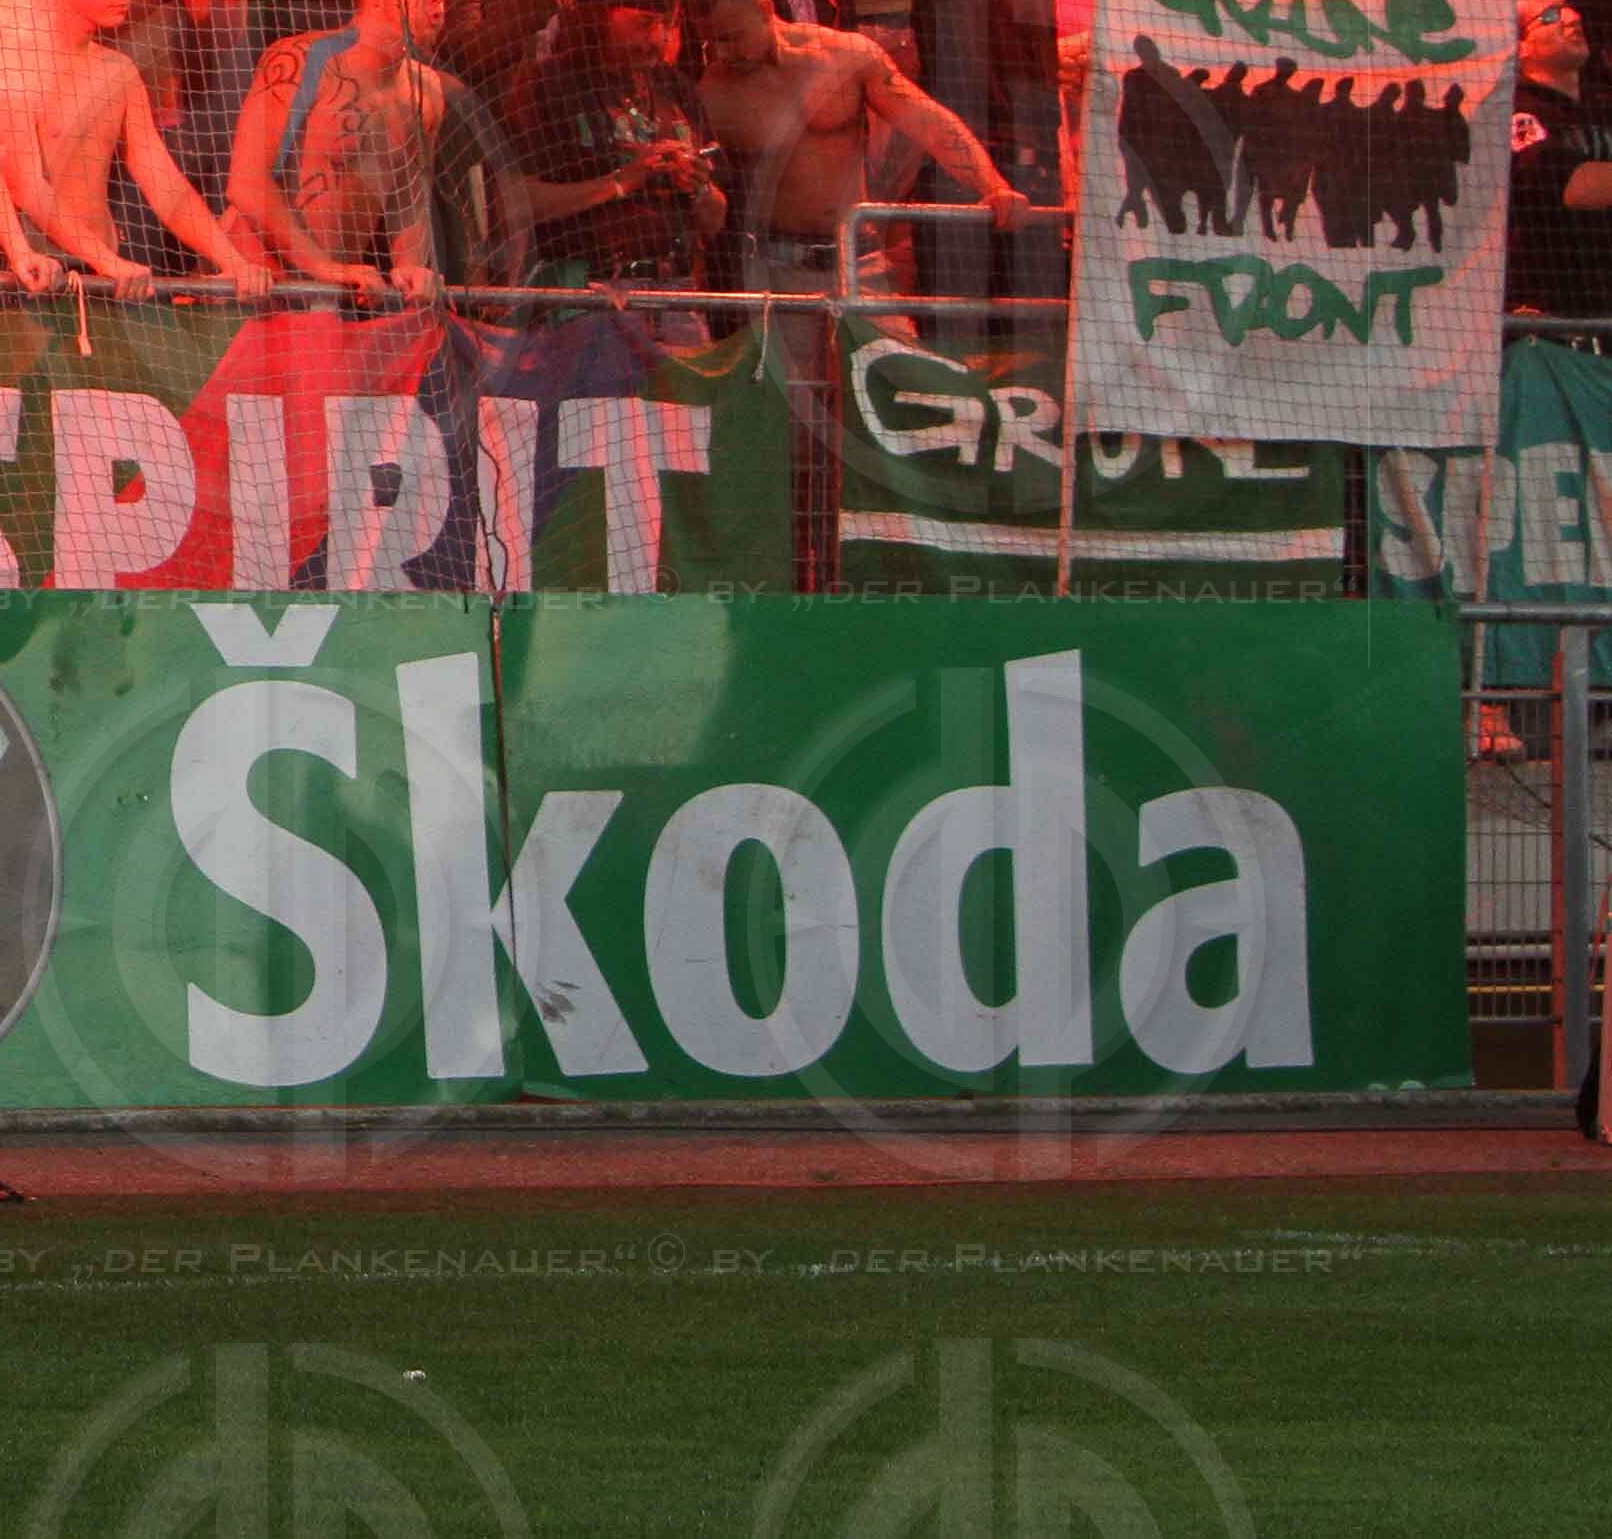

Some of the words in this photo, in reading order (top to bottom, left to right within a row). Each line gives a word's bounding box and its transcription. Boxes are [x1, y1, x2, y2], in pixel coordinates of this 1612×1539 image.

[1130, 255, 1445, 347] FRONT
[1378, 442, 1612, 602] SPE
[169, 602, 1316, 1089] Škoda
